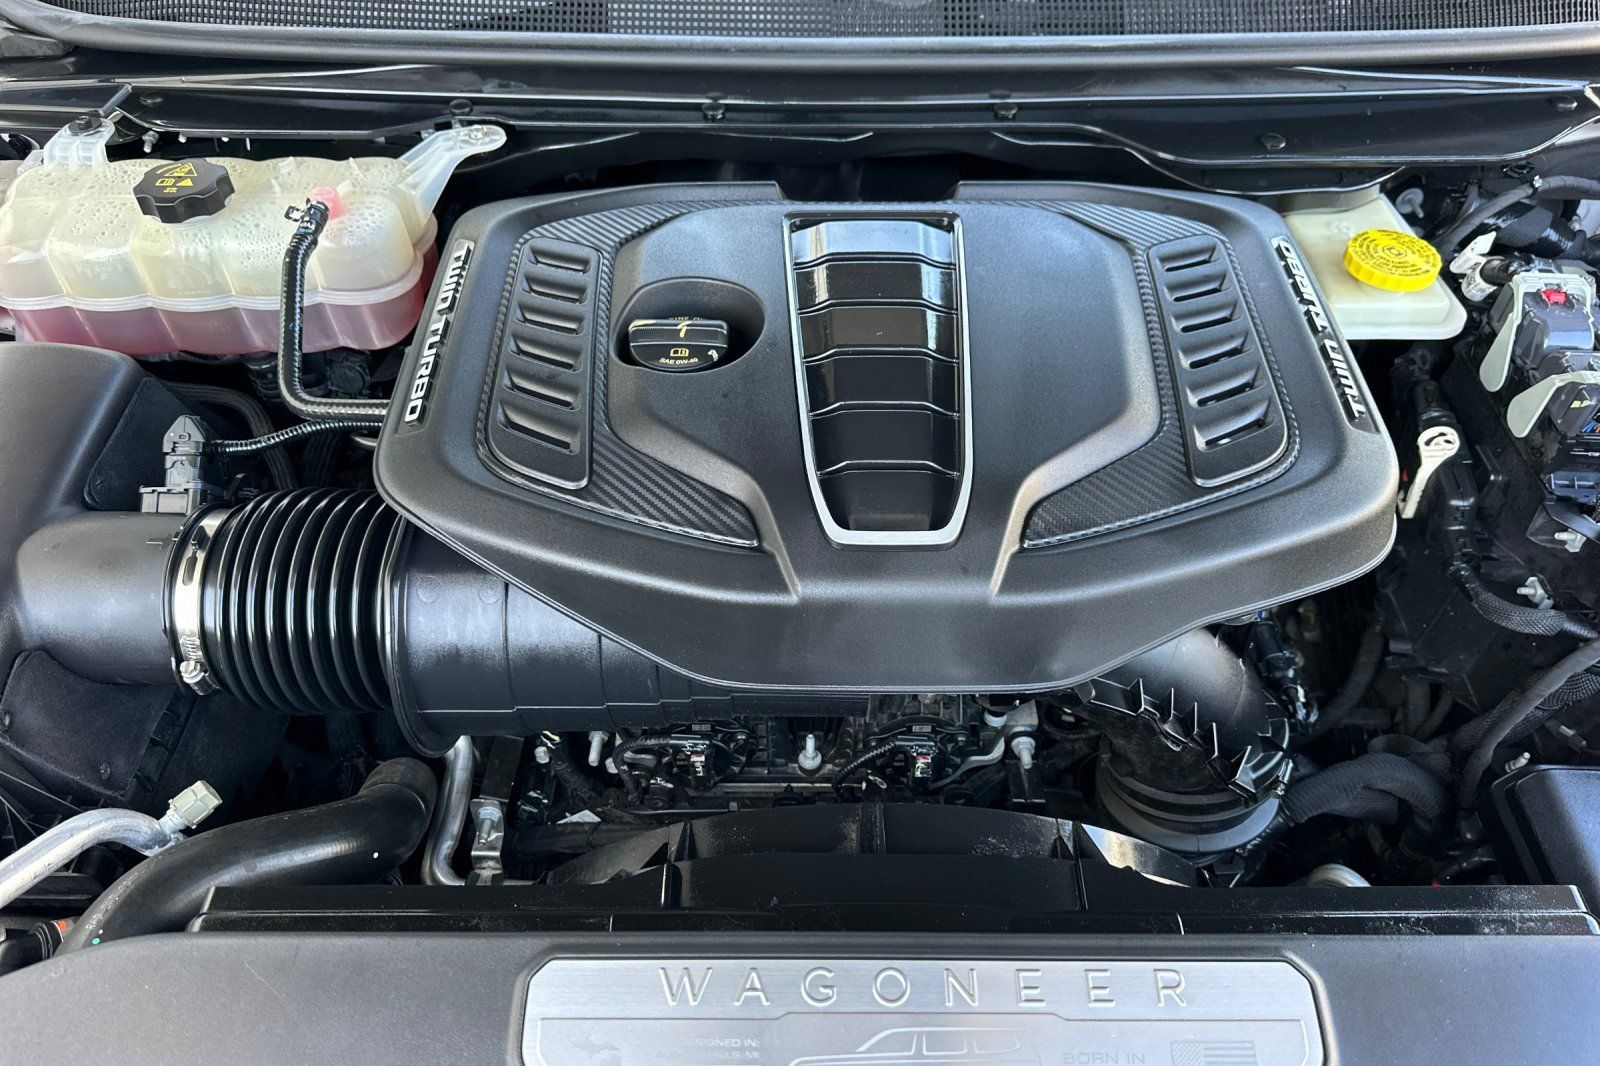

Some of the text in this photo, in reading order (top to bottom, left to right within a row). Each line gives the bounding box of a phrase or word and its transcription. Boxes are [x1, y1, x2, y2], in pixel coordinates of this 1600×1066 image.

[404, 242, 471, 424] TWIN TURBO
[1278, 240, 1365, 420] TWIN TURBO
[659, 357, 675, 365] SAE
[658, 966, 1188, 1008] WAGONEER
[1063, 1052, 1145, 1064] BORN IN
